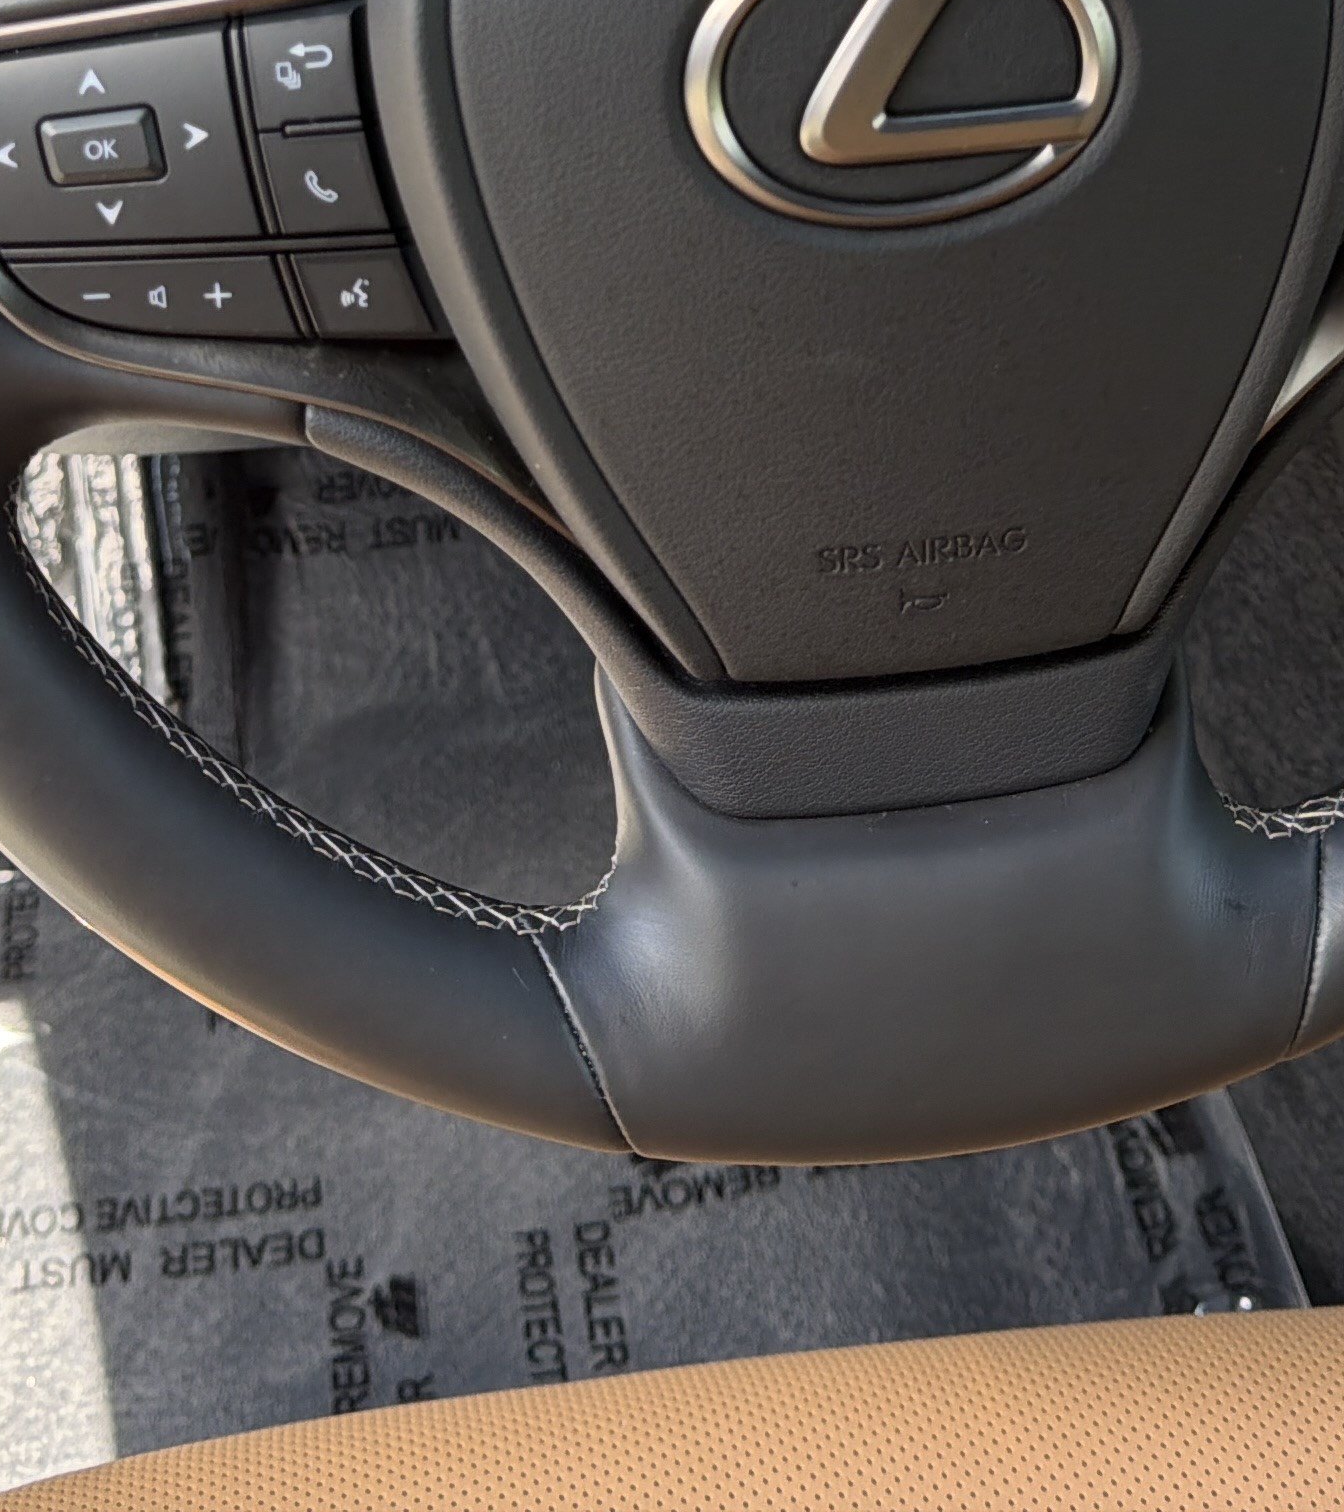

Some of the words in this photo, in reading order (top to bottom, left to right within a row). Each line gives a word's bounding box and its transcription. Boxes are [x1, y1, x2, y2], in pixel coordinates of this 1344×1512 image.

[83, 137, 119, 161] OK
[817, 544, 885, 575] SRS
[896, 526, 1030, 568] AIRBAG
[95, 1175, 324, 1237] PROTECTIVE
[19, 1248, 134, 1288] MUST
[161, 1226, 327, 1281] DEALER
[574, 1220, 630, 1373] DEALER
